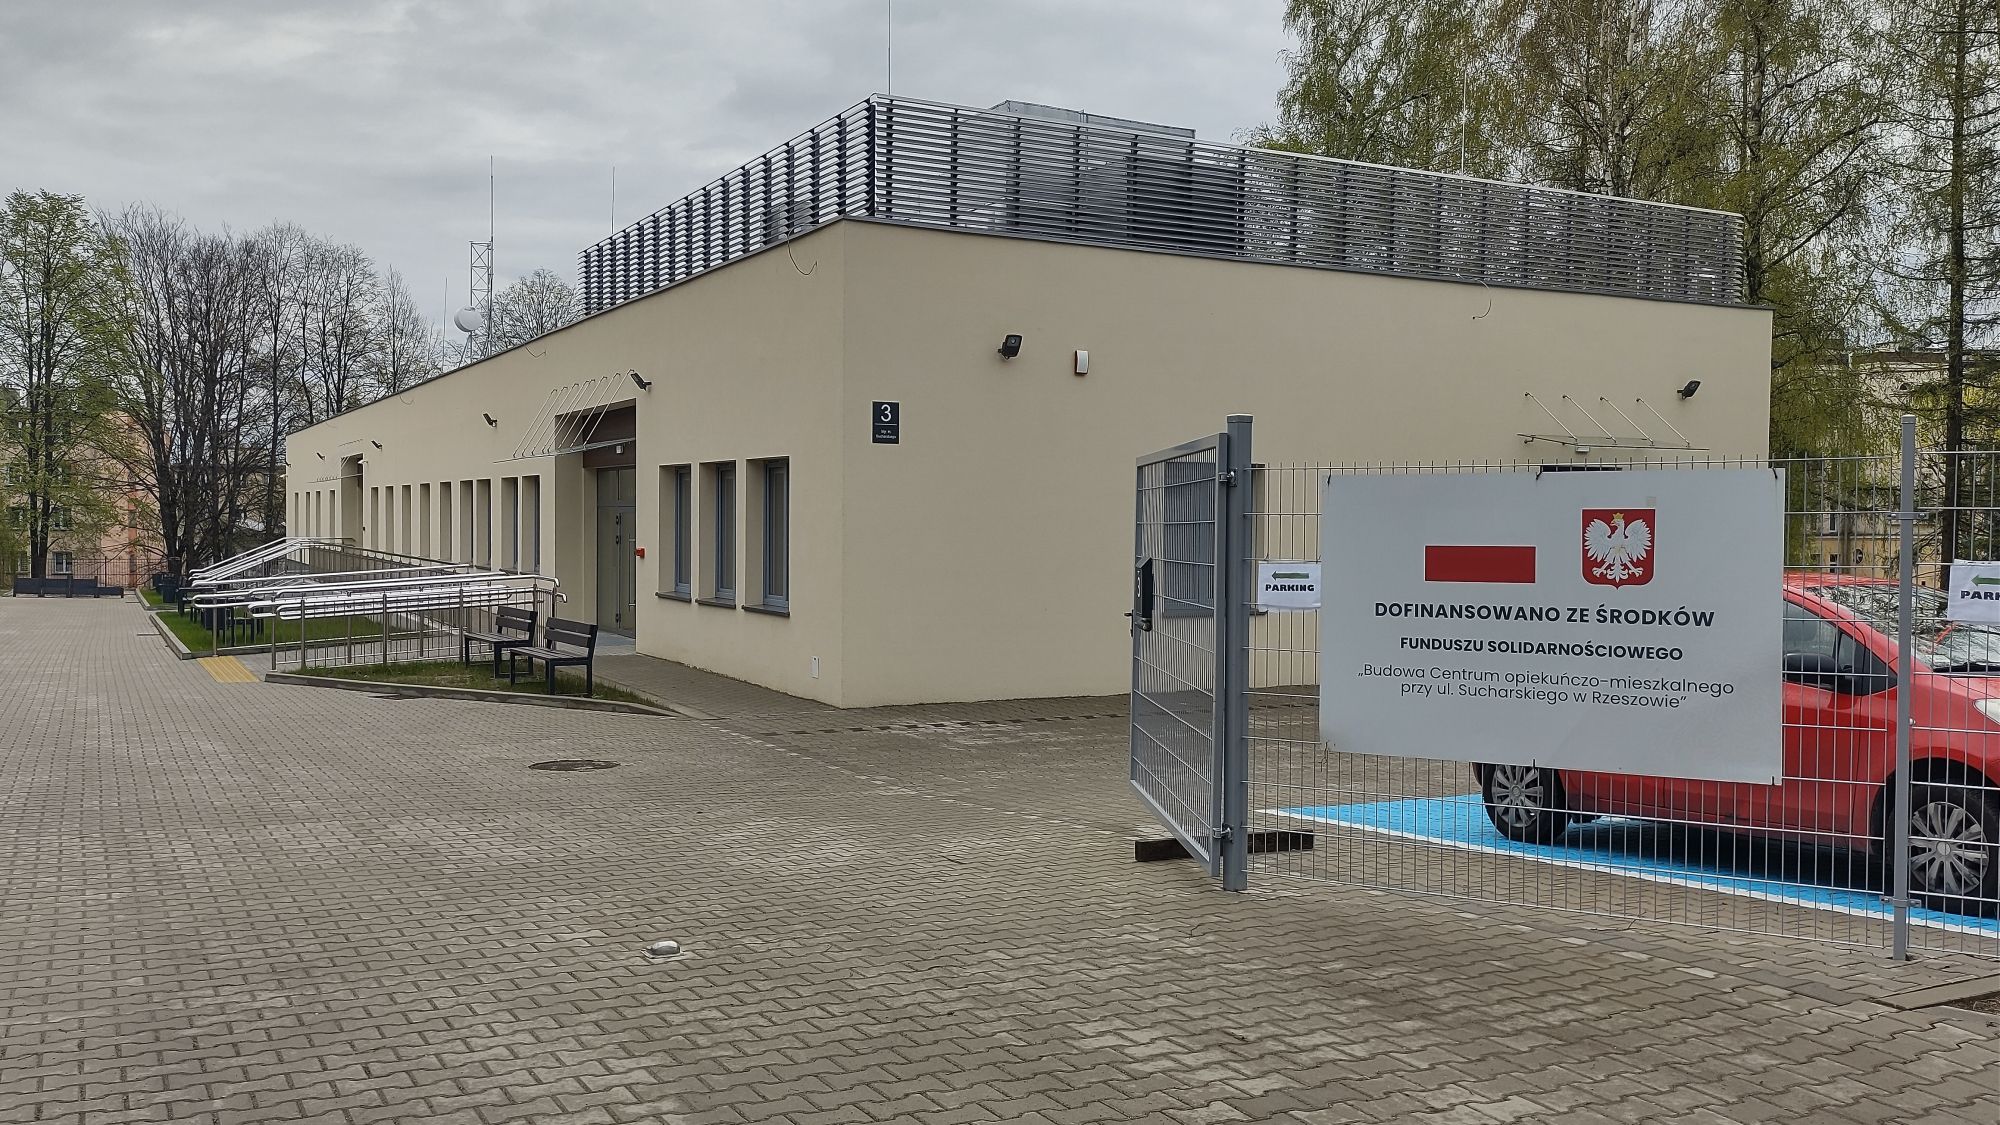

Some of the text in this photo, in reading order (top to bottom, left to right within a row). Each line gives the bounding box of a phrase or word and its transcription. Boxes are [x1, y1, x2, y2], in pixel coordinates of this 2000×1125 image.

[880, 404, 892, 422] 3
[1265, 584, 1315, 592] PARKING
[1375, 602, 1715, 627] DOFINANSOWANO ZE ŚRODKÓW
[1400, 637, 1683, 661] FUNDUSZU SOLIDARNOŚCIOWEGO
[1401, 682, 1433, 698] przy
[1437, 683, 1454, 696] ul.
[1458, 684, 1568, 705] Sucharskiego
[1573, 691, 1587, 703] w
[1429, 667, 1500, 682] Centrum
[1504, 671, 1735, 698] opiekuńczo-mieszkalnego
